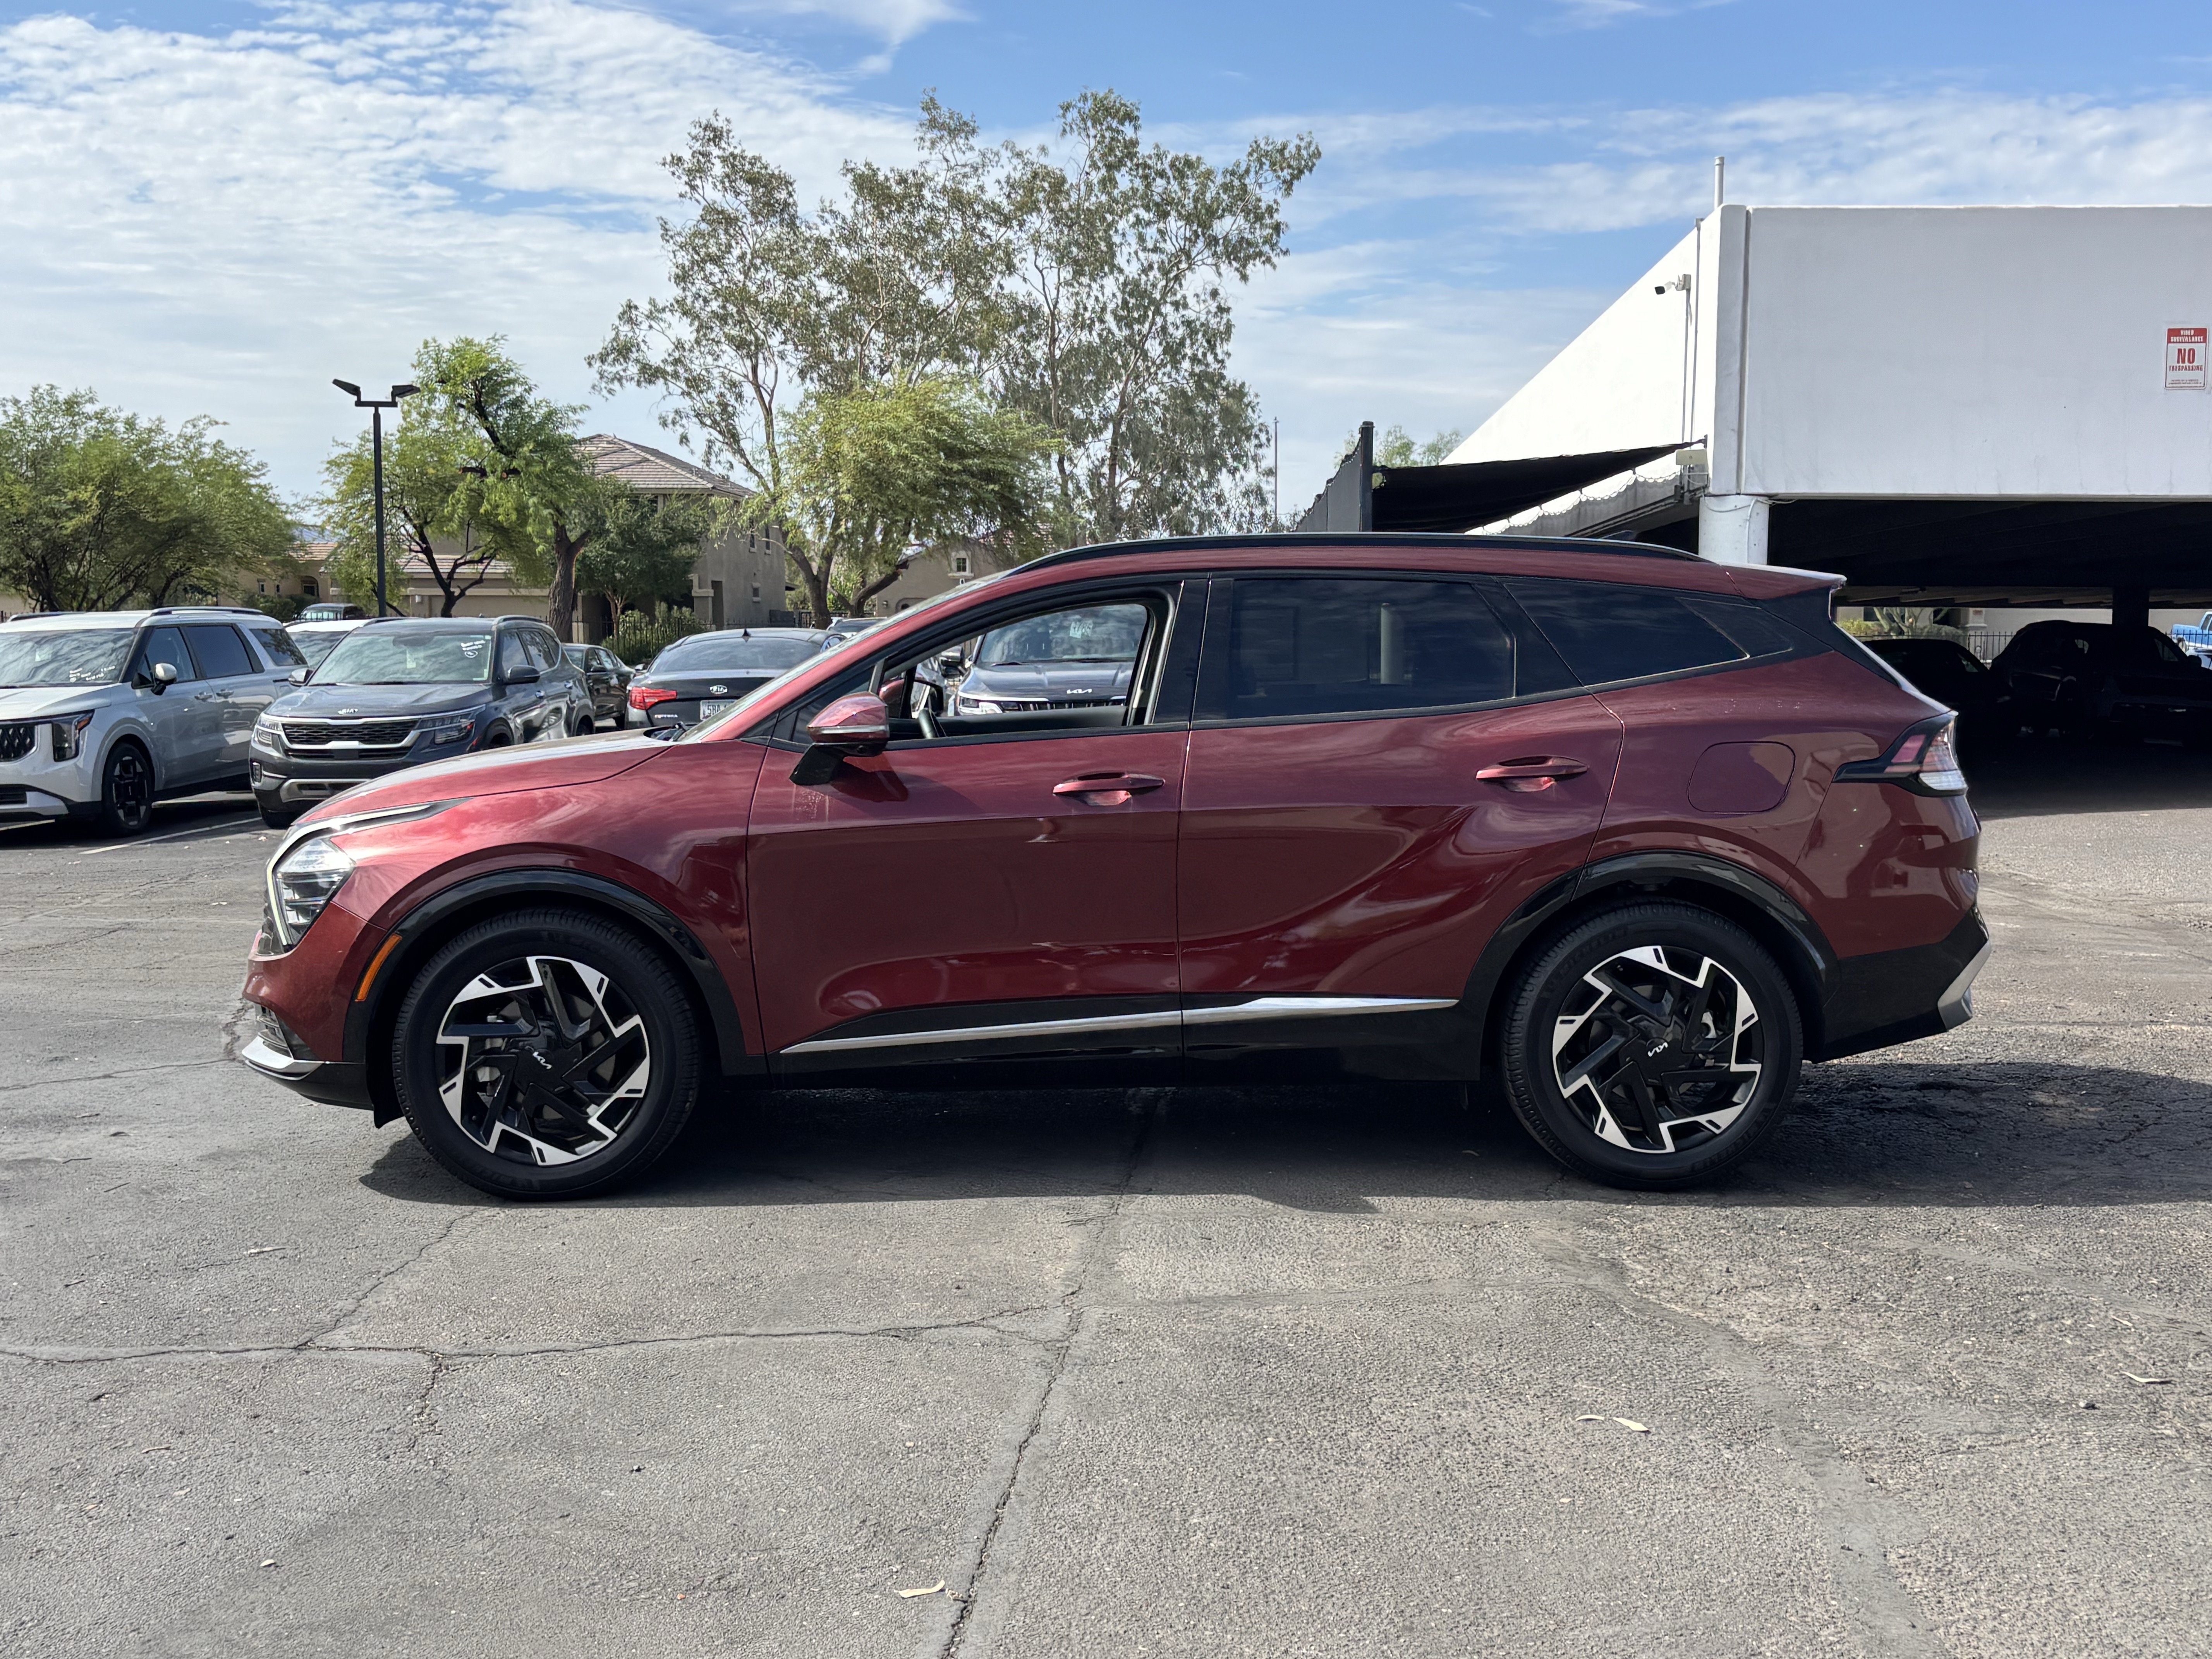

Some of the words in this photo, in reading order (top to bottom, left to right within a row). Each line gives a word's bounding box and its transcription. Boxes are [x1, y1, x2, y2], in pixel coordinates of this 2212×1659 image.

[2177, 348, 2196, 364] NO
[1648, 1042, 1668, 1057] KIA
[533, 1051, 552, 1069] KIA
